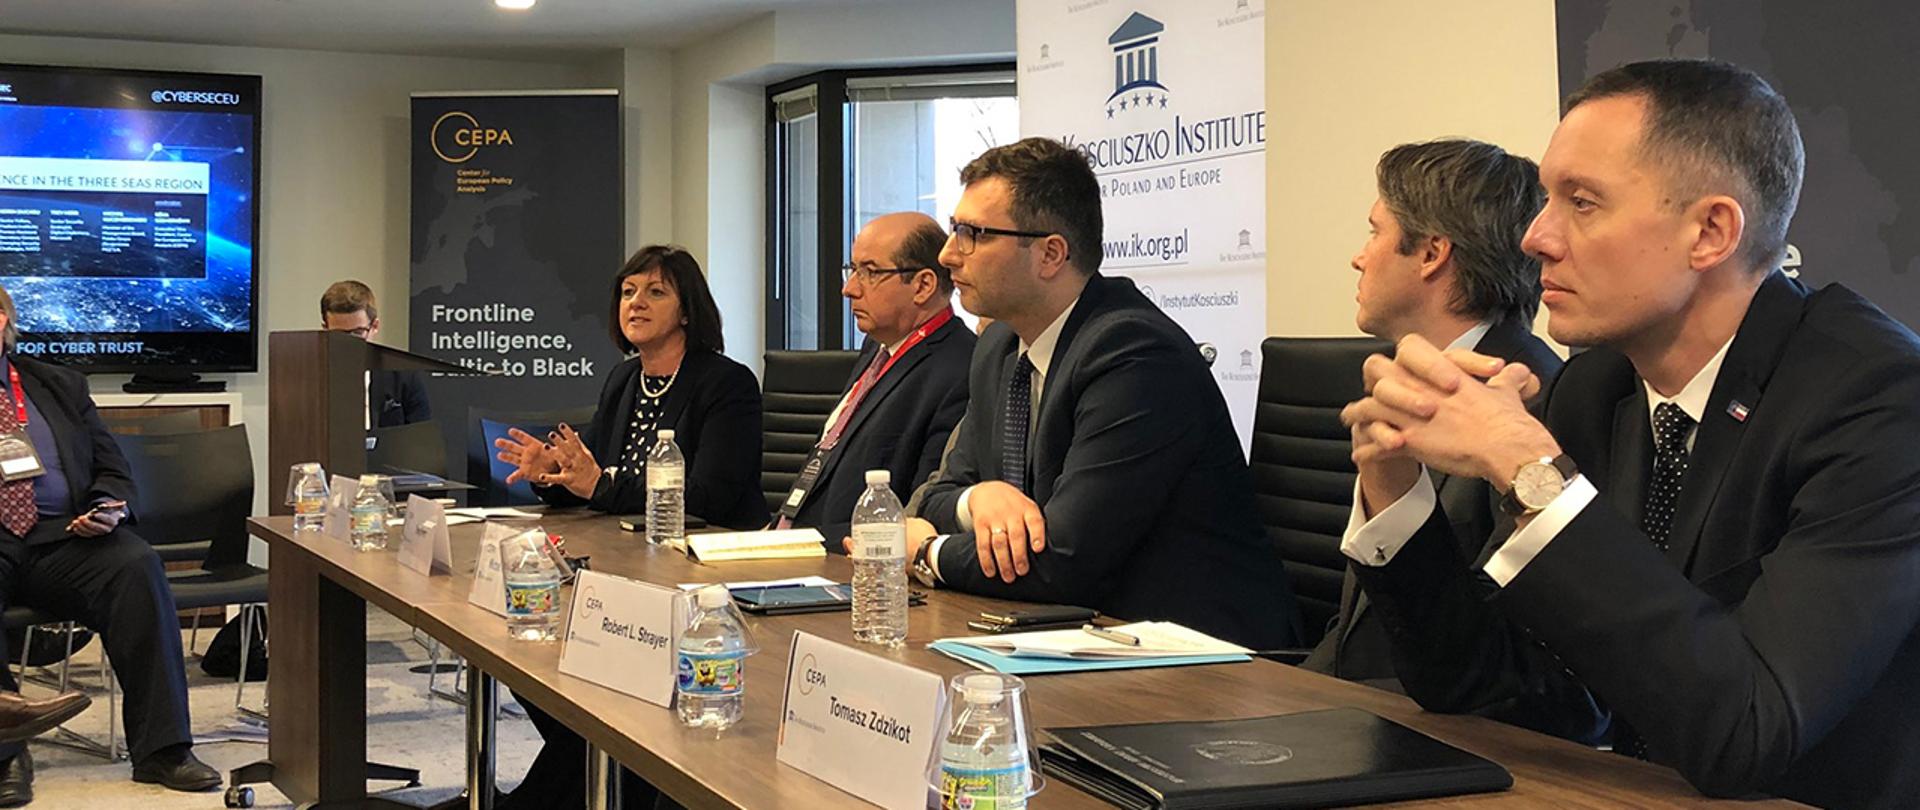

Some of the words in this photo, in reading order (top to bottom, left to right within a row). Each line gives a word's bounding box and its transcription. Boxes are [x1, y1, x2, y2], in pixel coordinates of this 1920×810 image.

[151, 91, 240, 105] @CYBERSECEU
[455, 128, 513, 146] CEPA
[1175, 111, 1265, 157] INSTITUTE
[0, 174, 28, 186] NCE
[32, 175, 46, 186] IN
[49, 175, 74, 188] THE
[78, 176, 118, 189] THREE
[121, 177, 152, 190] SEAS
[155, 178, 203, 190] REGION
[1111, 178, 1151, 198] POLAND
[1155, 175, 1175, 191] AND
[1180, 168, 1221, 188] EUROPE
[1102, 228, 1189, 261] ww.ik.org.pl
[431, 303, 535, 323] Frontline
[16, 342, 46, 354] FOR
[49, 342, 97, 354] CYBER
[99, 341, 144, 354] TRUST
[431, 330, 573, 354] Intelligence,
[432, 357, 496, 377] ltic
[501, 358, 526, 377] to
[532, 357, 595, 377] Black
[585, 597, 604, 611] CEPA
[601, 616, 629, 638] Robert
[628, 623, 636, 640] L.
[637, 626, 669, 650] Strayer
[805, 668, 827, 688] CEPA
[829, 695, 867, 728] Tomasz
[868, 710, 912, 744] Zdzikot
